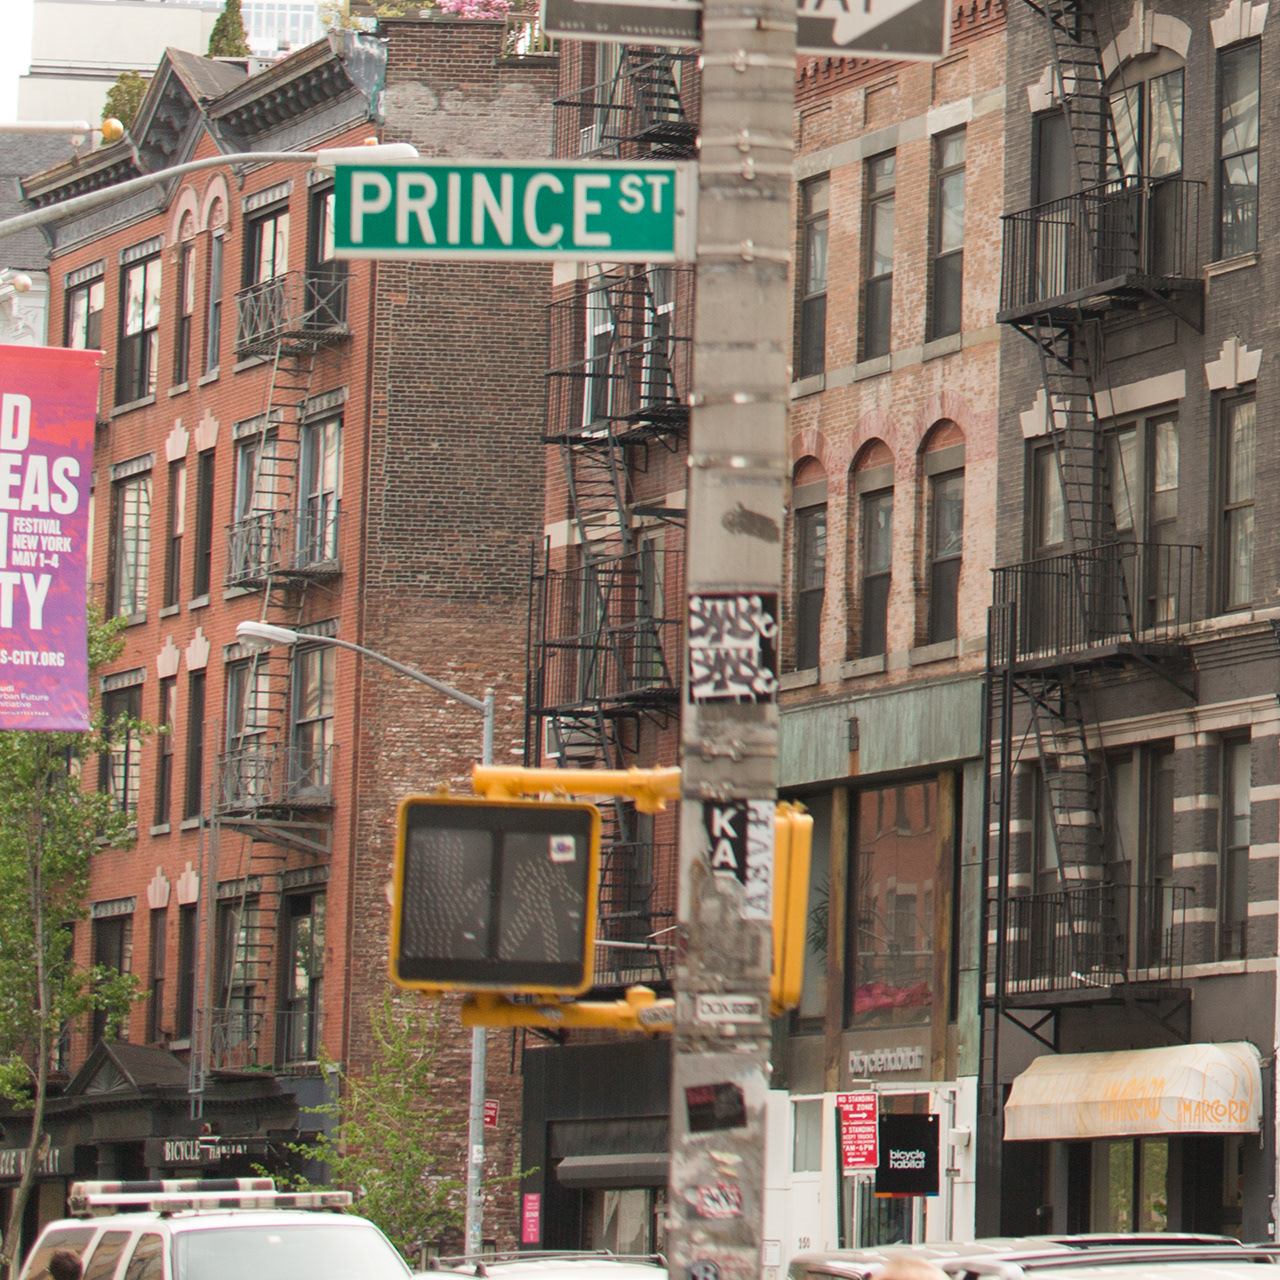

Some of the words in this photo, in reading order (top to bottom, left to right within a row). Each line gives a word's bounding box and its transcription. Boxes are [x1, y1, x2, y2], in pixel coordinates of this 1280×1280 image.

[350, 172, 611, 247] PRINCE
[619, 174, 670, 214] ST
[13, 517, 61, 535] FESTIVAL
[13, 534, 38, 551] NEW
[41, 536, 72, 552] YORK
[12, 551, 37, 568] MAY
[21, 693, 49, 701] Future
[848, 1095, 874, 1103] STANDING
[1177, 1098, 1249, 1124] AMARCORD
[164, 1141, 200, 1161] BICYCLE
[889, 1149, 926, 1161] bicycle
[889, 1159, 926, 1169] habitat
